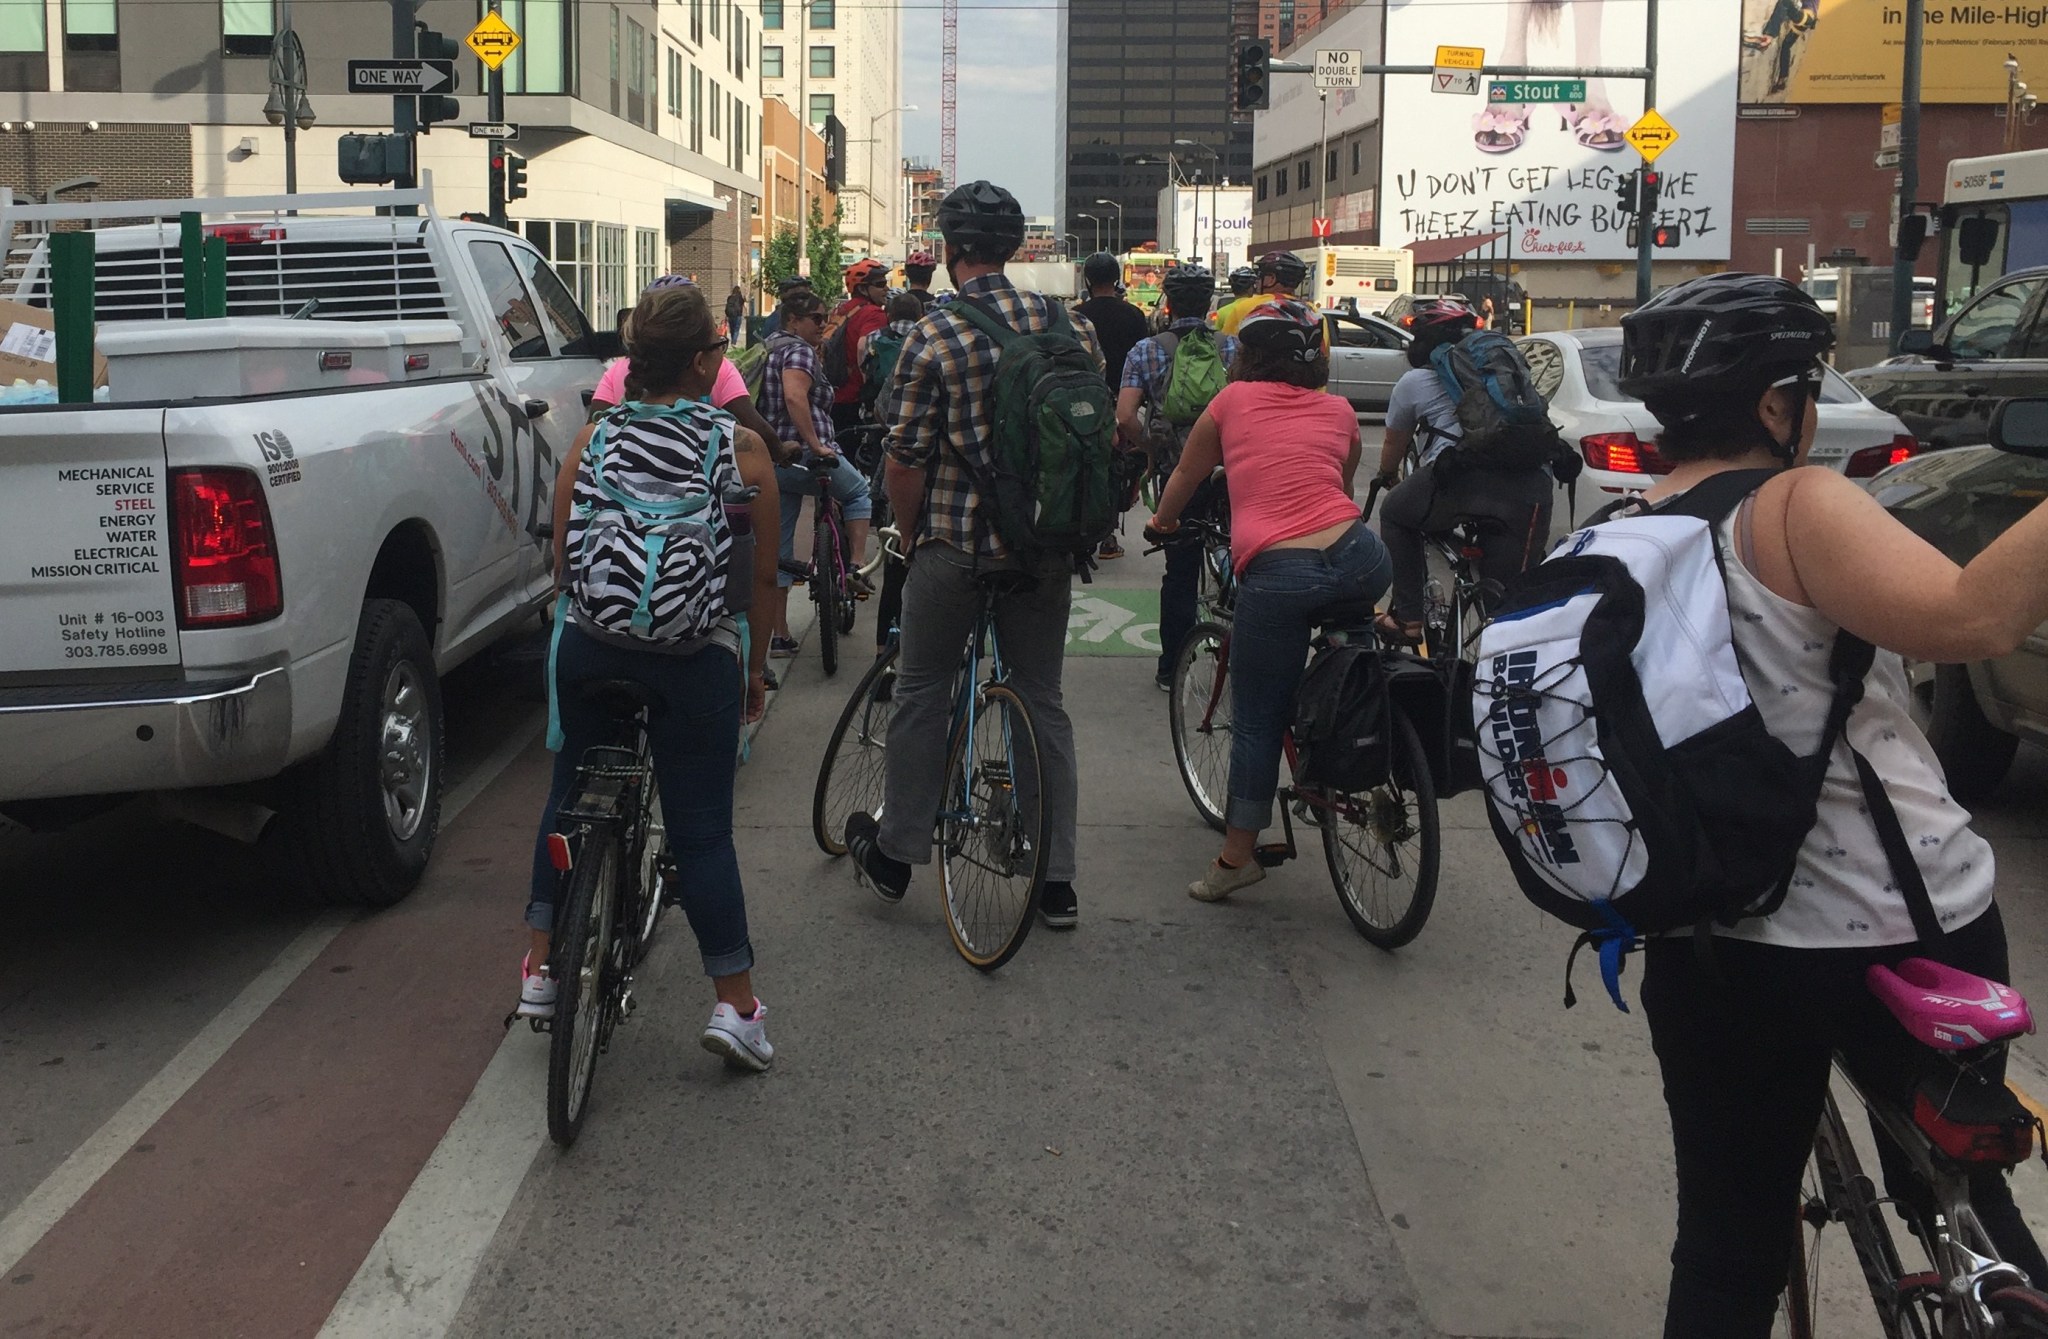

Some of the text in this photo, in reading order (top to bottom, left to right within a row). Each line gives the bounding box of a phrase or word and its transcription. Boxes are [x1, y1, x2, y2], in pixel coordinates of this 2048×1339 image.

[1883, 6, 1901, 24] in
[1951, 6, 2048, 28] Mile-High
[1328, 52, 1349, 64] NO
[1447, 50, 1474, 58] TURNING
[1443, 58, 1475, 66] VEHICLES
[359, 70, 422, 83] ONE WAY
[1318, 66, 1357, 75] DOUBLE
[1325, 77, 1352, 86] TURN
[1513, 84, 1560, 99] Stout
[1397, 165, 1698, 200] U DON'T GET LEG IKE
[1400, 200, 1717, 237] THEEZ EATING BUERZ
[1315, 220, 1328, 235] Y
[1521, 229, 1586, 255] Chick-fil-A
[1769, 331, 1812, 341] SPECIALIZED
[58, 467, 154, 481] MECHANICAL
[269, 470, 301, 487] CERTIFIED
[96, 482, 154, 496] SERVICE
[115, 498, 155, 511] STEEL
[99, 514, 156, 527] ENERGY
[106, 530, 156, 543] WATER
[74, 546, 158, 560] ELECTRICAL
[31, 562, 159, 578] MISSION CRITICAL
[59, 610, 164, 626] Unit # 16-003
[62, 626, 166, 641] Safety Hotline
[65, 643, 168, 658] 303.785.6998
[1489, 654, 1529, 801] BOULDER
